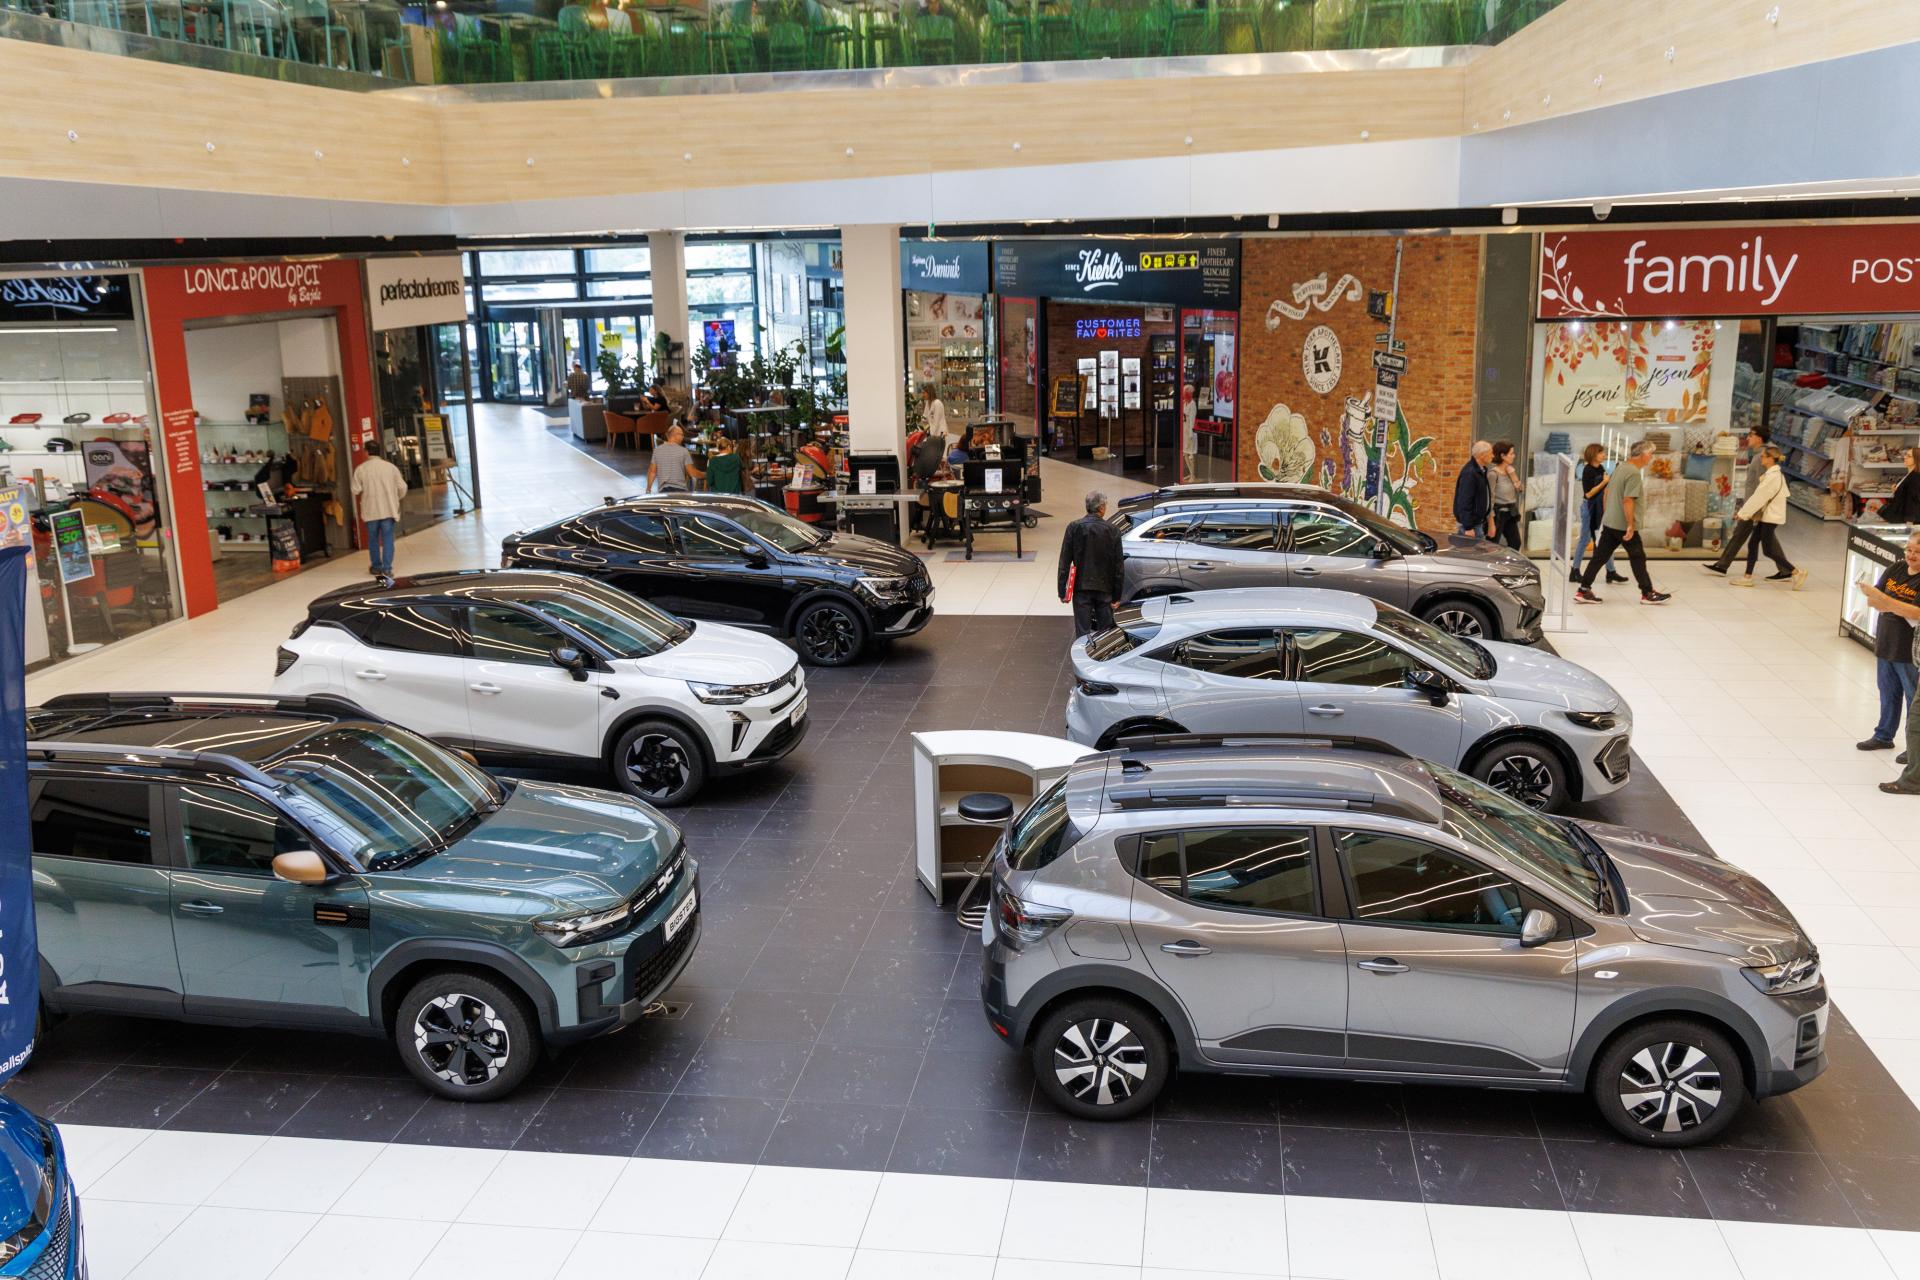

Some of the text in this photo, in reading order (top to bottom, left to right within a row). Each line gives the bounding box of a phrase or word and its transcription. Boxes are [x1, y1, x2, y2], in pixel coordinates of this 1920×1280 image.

[184, 268, 240, 294] LONCI
[249, 265, 320, 289] POKLOPCI
[925, 254, 961, 279] Dominik
[1076, 248, 1124, 283] Kiehl's
[1623, 235, 1799, 306] family
[288, 287, 297, 306] by
[1076, 318, 1141, 328] CUSTOMER
[1563, 384, 1621, 415] jeseni
[669, 897, 693, 932] BIGSTER
